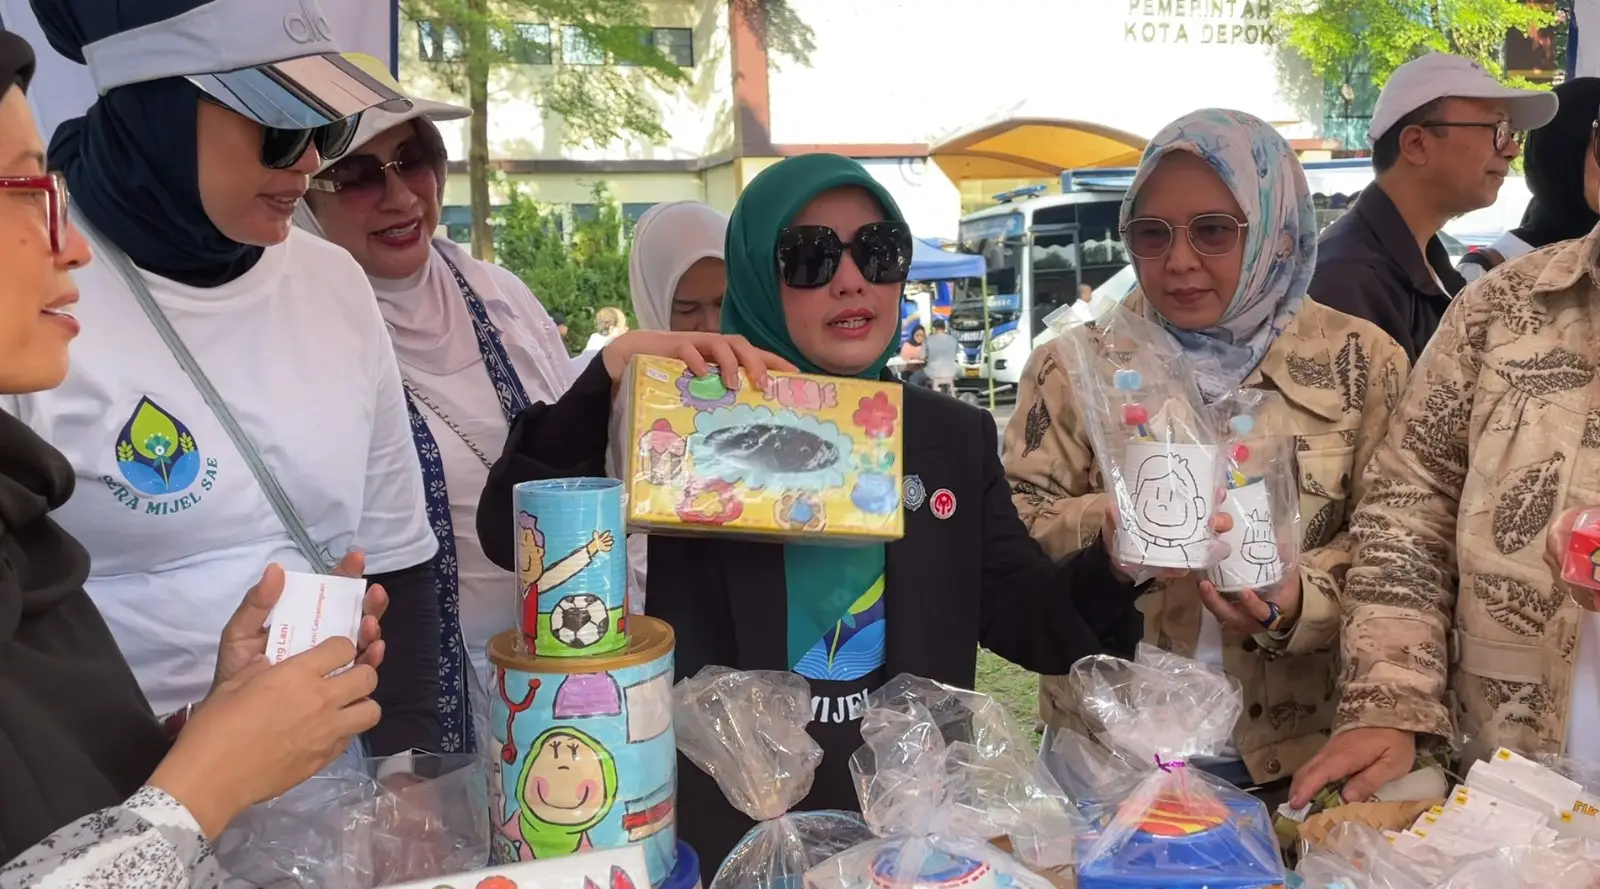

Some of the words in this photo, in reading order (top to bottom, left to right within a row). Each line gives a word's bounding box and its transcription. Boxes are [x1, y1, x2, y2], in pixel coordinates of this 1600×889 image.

[1128, 0, 1271, 19] PEMERINTAH
[1124, 22, 1188, 43] KOTA
[1201, 24, 1274, 45] DEPOK
[145, 492, 201, 515] MIJEL
[201, 457, 218, 491] SAE
[277, 623, 289, 645] Lani
[276, 647, 287, 662] ng
